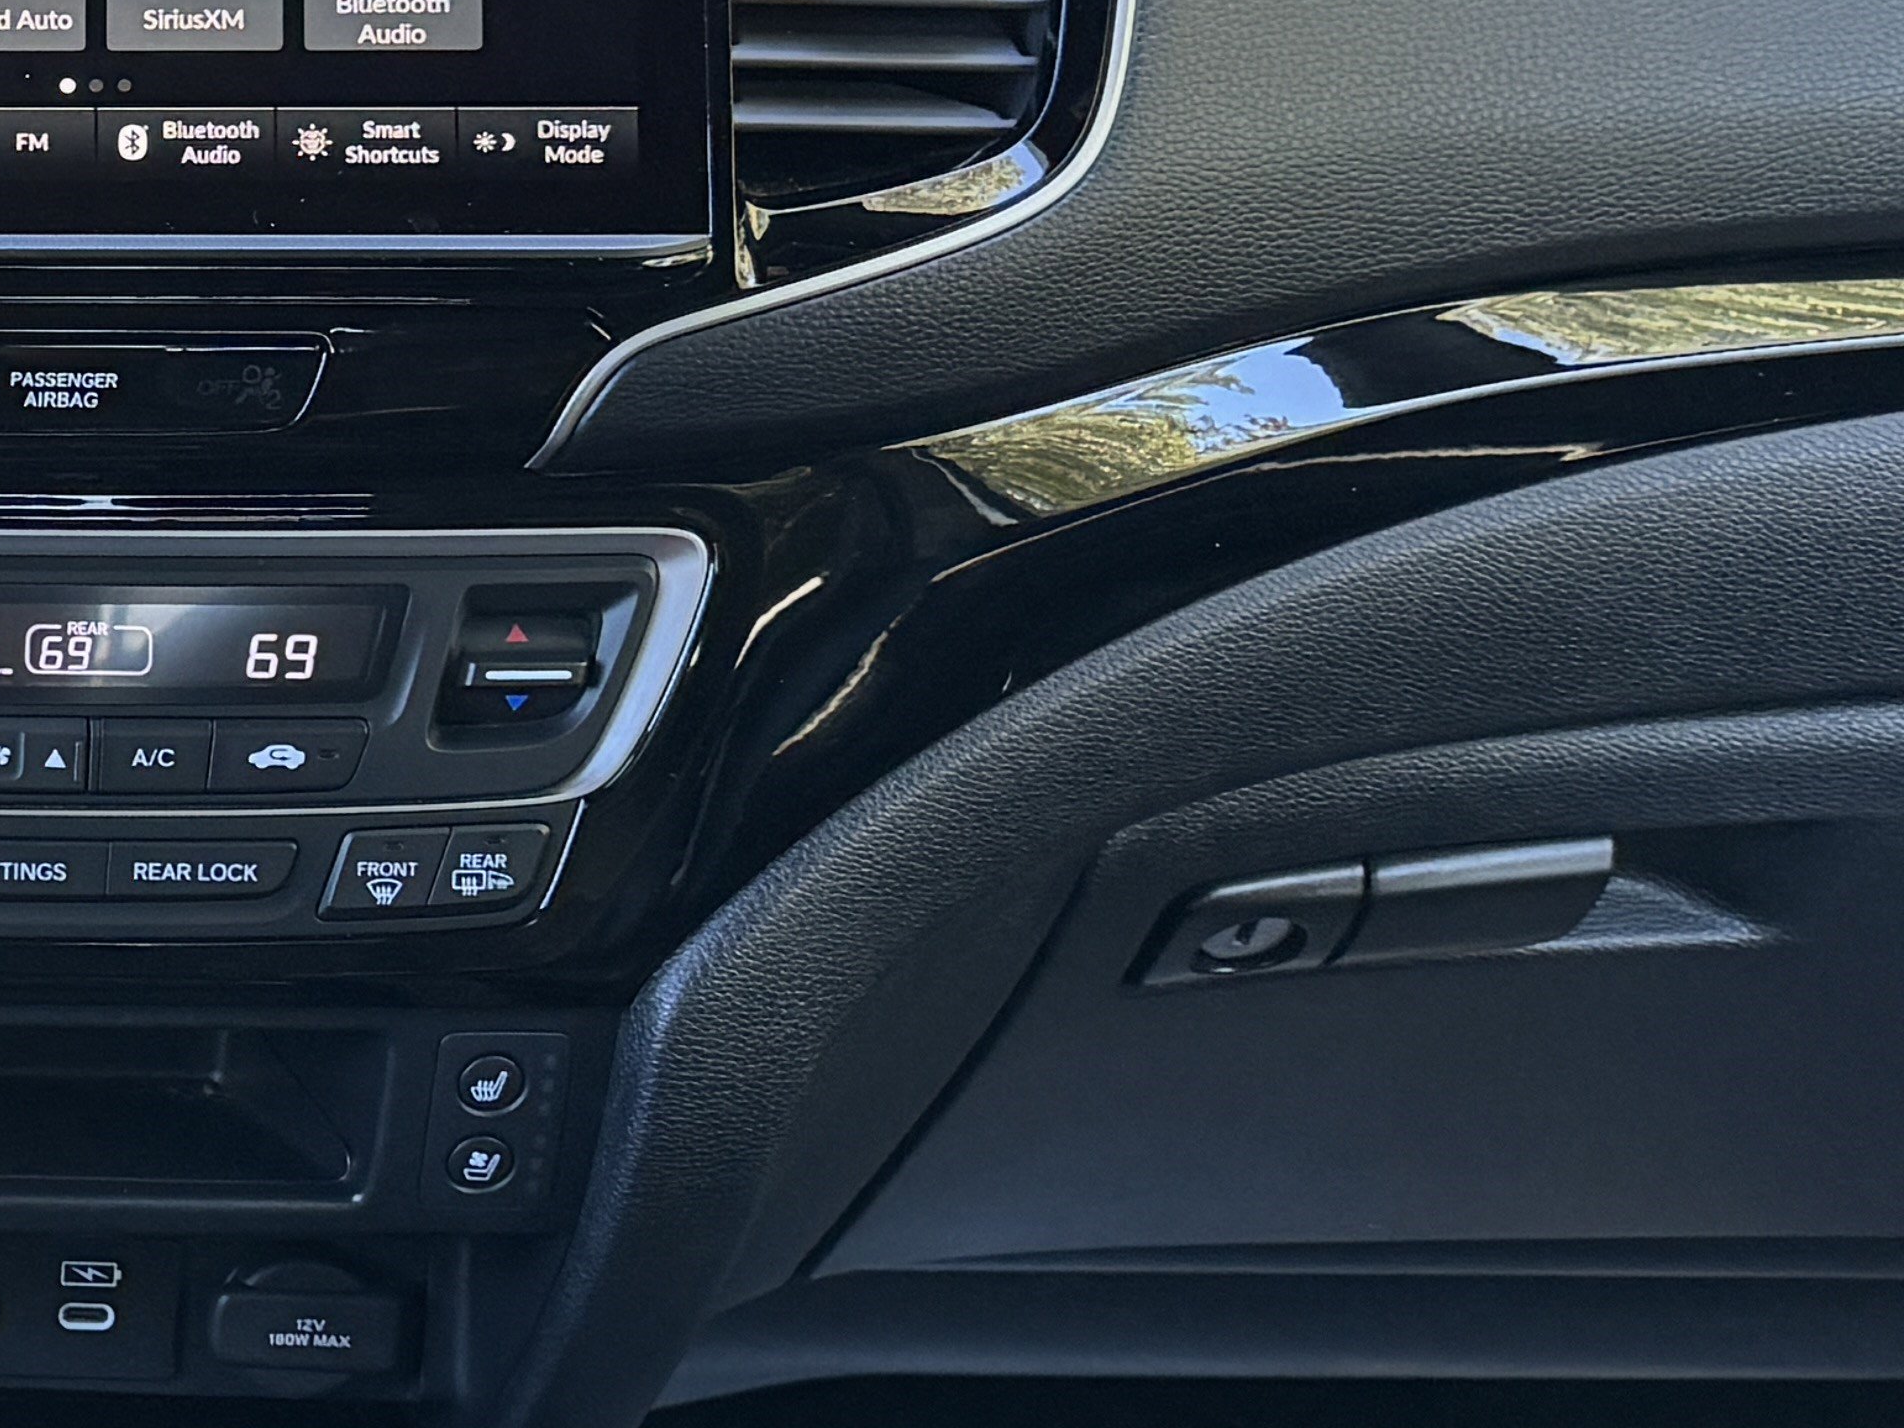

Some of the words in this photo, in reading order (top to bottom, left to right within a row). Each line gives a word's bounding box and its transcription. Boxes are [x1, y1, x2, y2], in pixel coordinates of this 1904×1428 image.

[16, 10, 73, 30] Auto
[144, 9, 244, 30] SiriusXM
[358, 23, 426, 44] Audio
[163, 120, 259, 139] Bluetooth
[363, 121, 421, 138] Smart
[538, 120, 611, 141] Display
[16, 133, 48, 151] FM
[181, 145, 241, 164] Audio
[345, 145, 439, 163] Shortcuts
[545, 145, 604, 163] Mode
[11, 372, 118, 388] PASSENGER
[24, 391, 98, 408] AIRBAG
[67, 621, 108, 637] REAR
[39, 636, 92, 671] 69
[246, 633, 318, 680] 69
[132, 749, 174, 767] A/C
[357, 862, 418, 877] FRONT
[460, 854, 507, 868] REAR
[134, 862, 191, 880] REAR
[198, 863, 257, 881] LOCK
[296, 1319, 325, 1332] 12V
[314, 1334, 351, 1349] MAX
